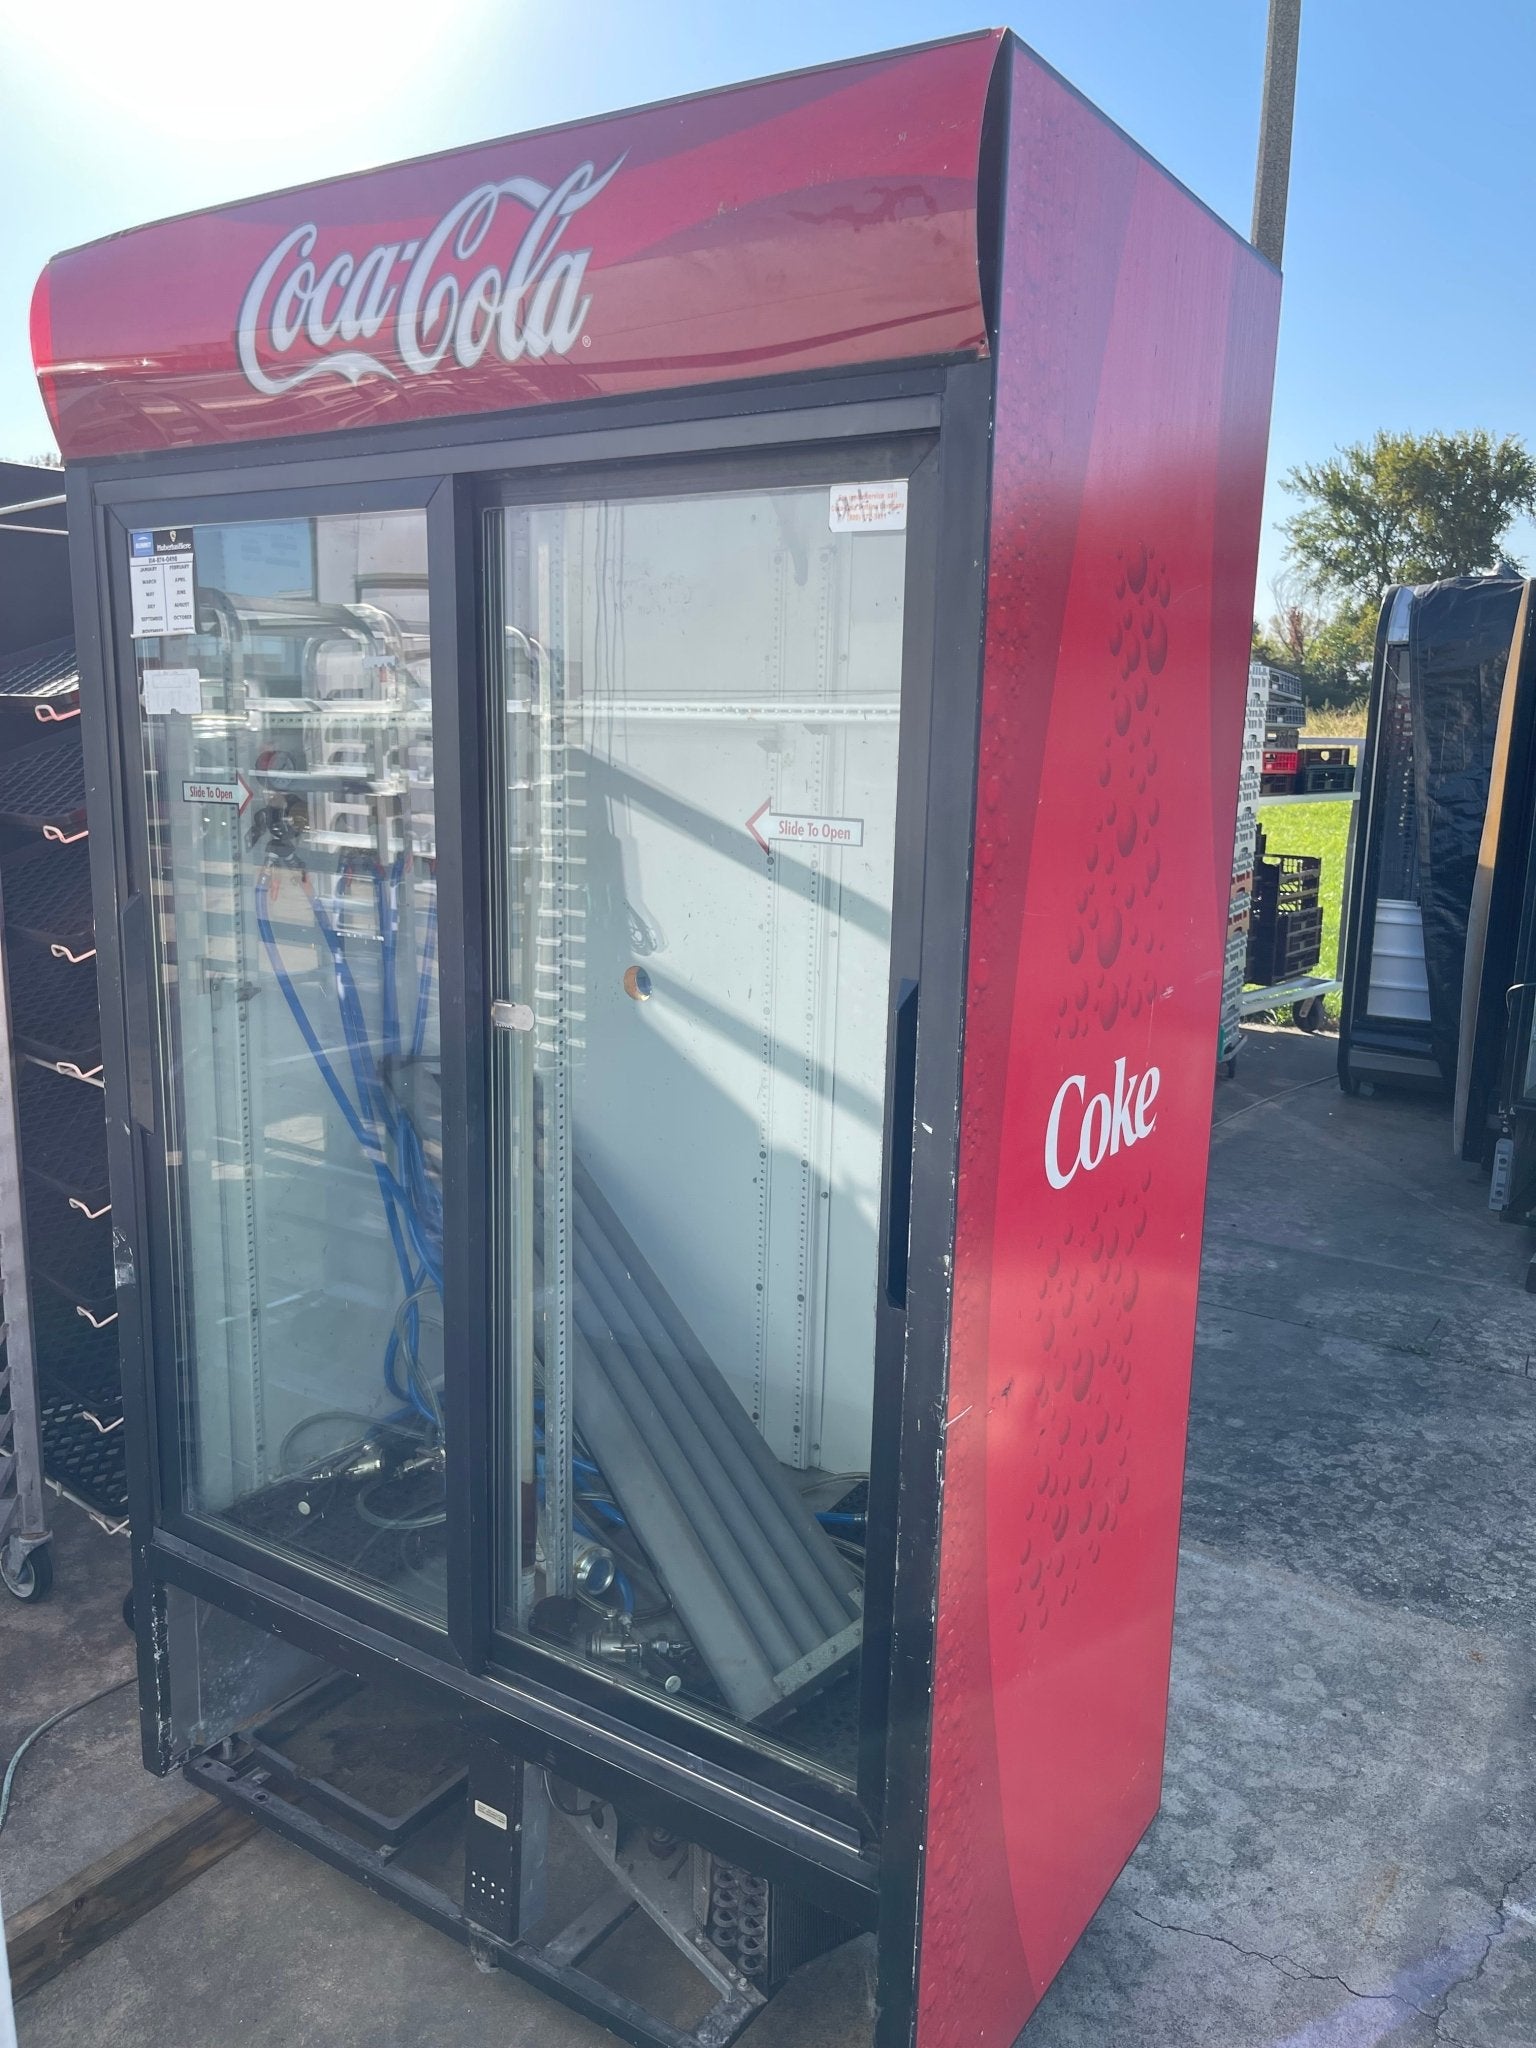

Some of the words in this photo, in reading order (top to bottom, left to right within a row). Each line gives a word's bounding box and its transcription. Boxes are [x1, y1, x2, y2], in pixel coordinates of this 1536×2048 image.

[236, 144, 632, 396] Coca-Cola
[189, 785, 206, 798] Slide
[206, 787, 214, 799] To
[215, 787, 233, 801] Open
[778, 820, 805, 836] Slide
[807, 822, 819, 837] To
[821, 823, 851, 842] Open
[1045, 1056, 1160, 1190] Coke
